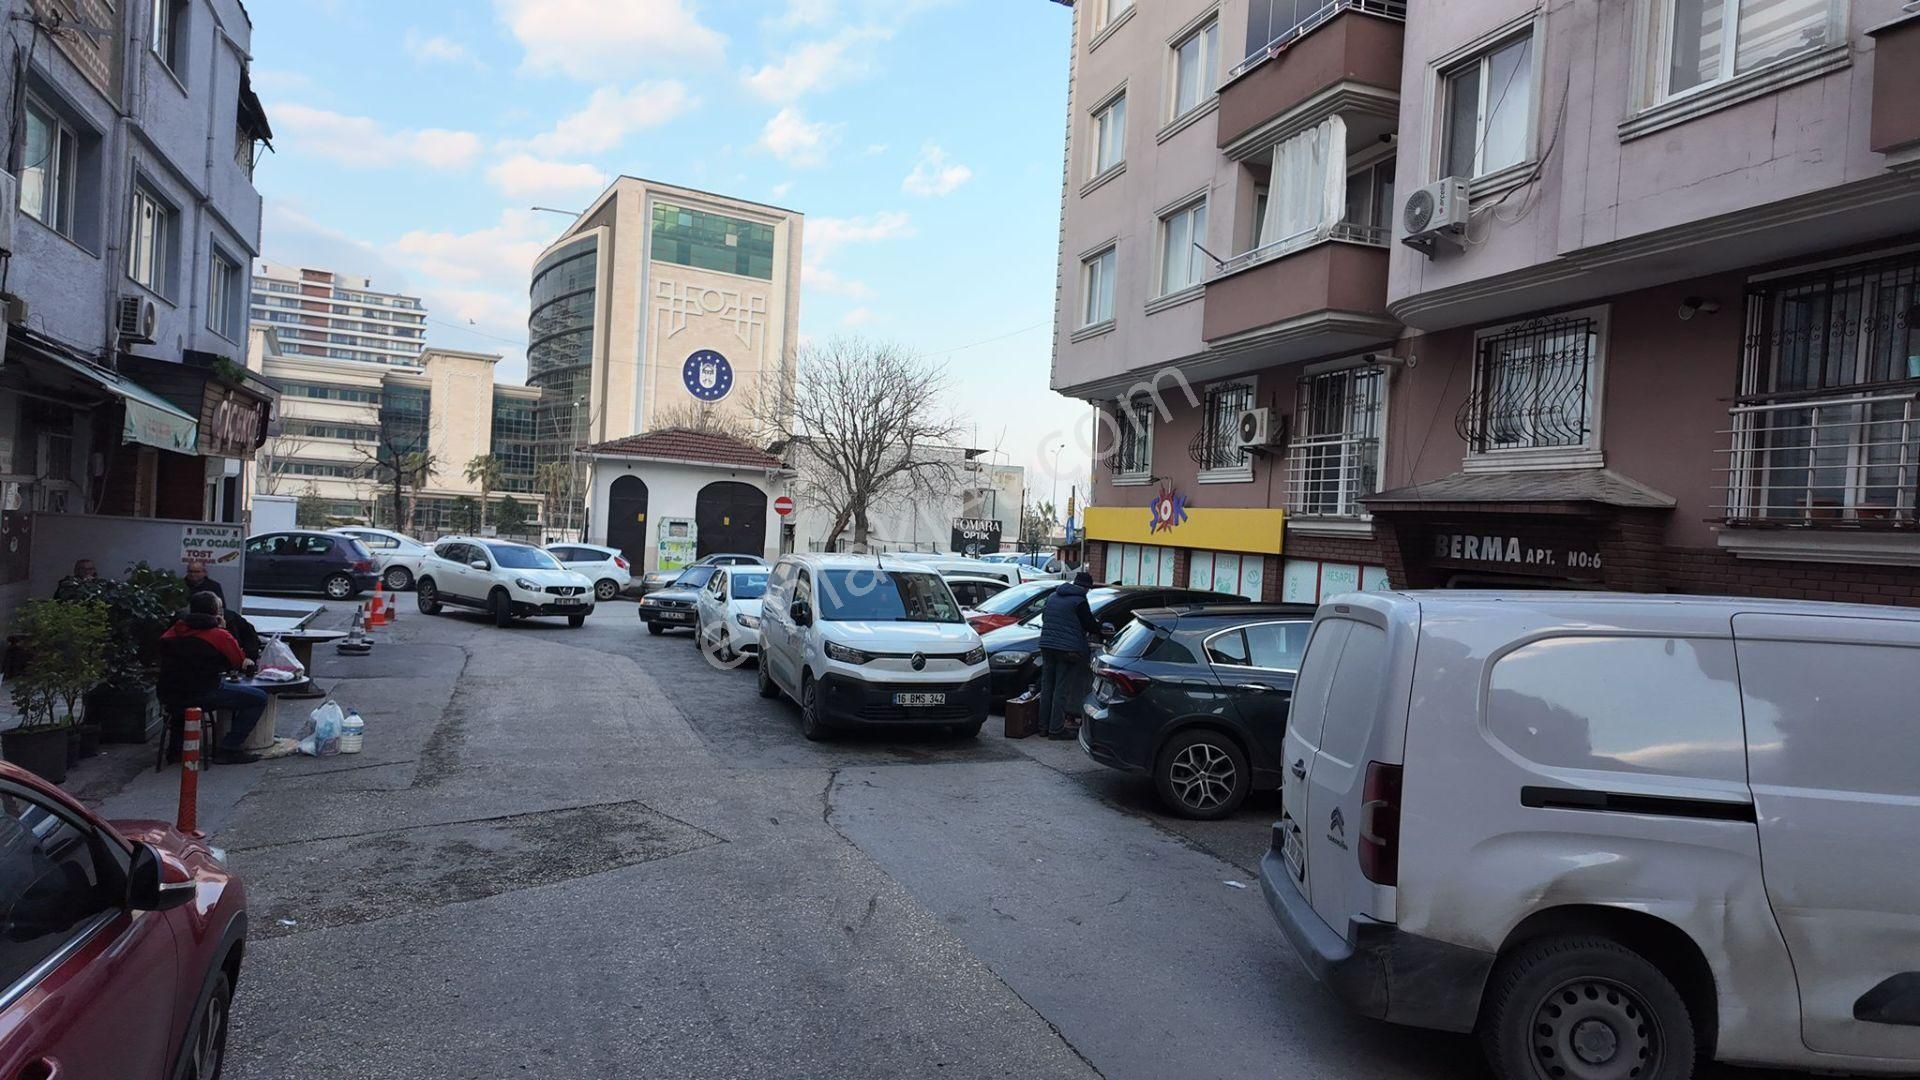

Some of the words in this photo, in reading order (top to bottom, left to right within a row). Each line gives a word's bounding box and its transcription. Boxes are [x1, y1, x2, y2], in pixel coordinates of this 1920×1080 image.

[183, 538, 204, 549] ÇAY
[186, 550, 213, 558] TOST
[1435, 535, 1521, 563] BERMA
[1526, 548, 1555, 565] APT.
[1567, 551, 1601, 568] NO:6
[897, 694, 906, 703] 16
[911, 694, 925, 703] BMS
[930, 694, 944, 703] 342
